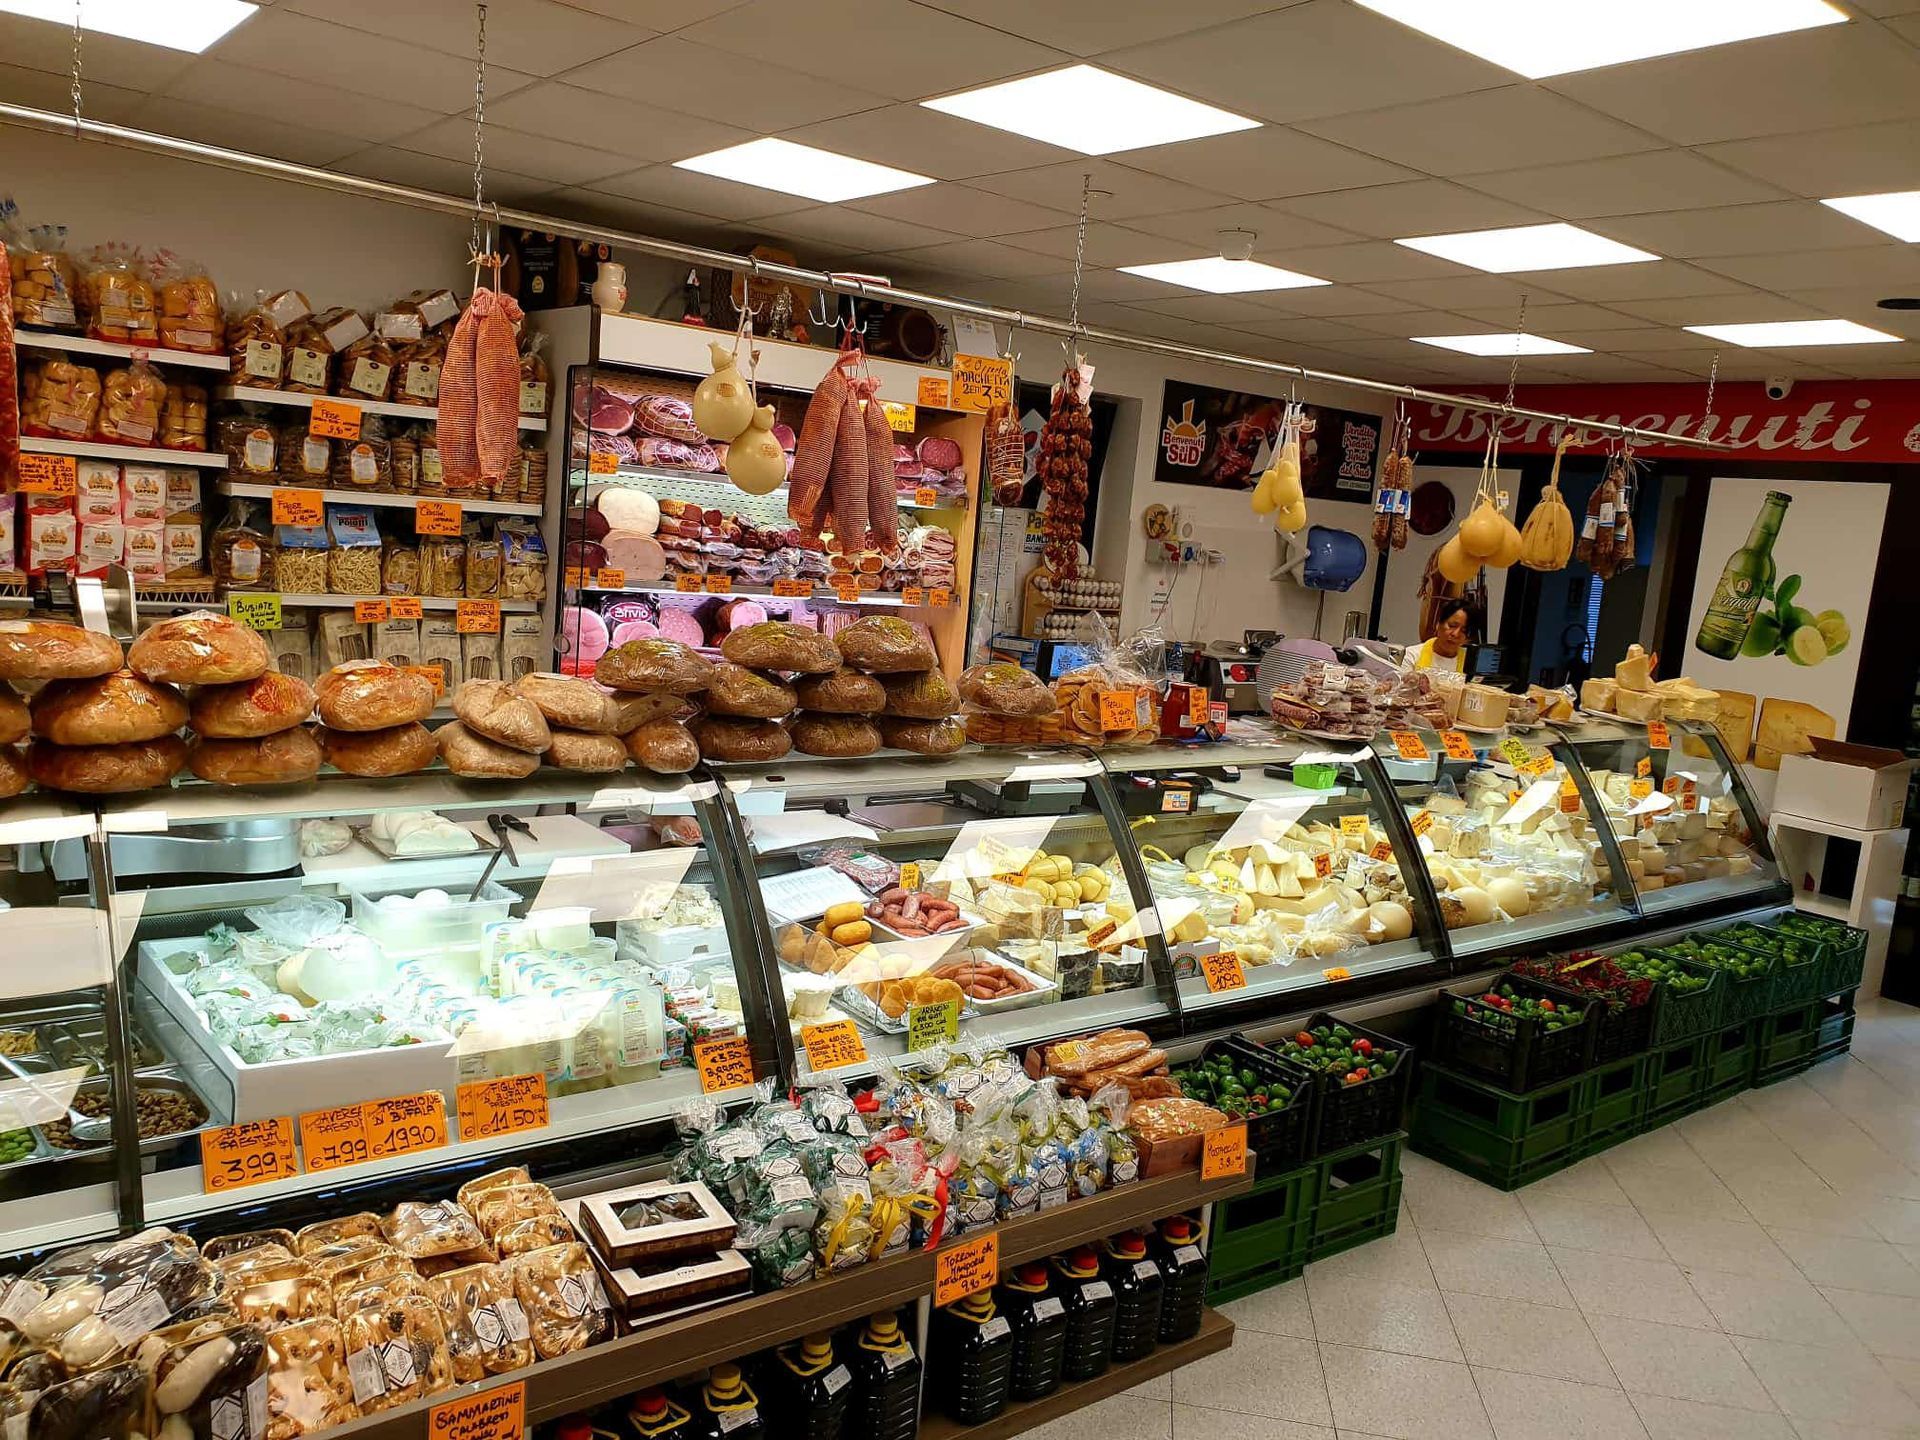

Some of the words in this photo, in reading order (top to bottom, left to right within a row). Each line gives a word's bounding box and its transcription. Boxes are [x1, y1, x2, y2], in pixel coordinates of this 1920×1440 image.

[1419, 394, 1870, 452] Benvenuti
[1162, 430, 1206, 451] Benvenuti
[614, 605, 649, 618] Brivio
[391, 1105, 435, 1122] BUFALA
[220, 1119, 279, 1140] BUFALA
